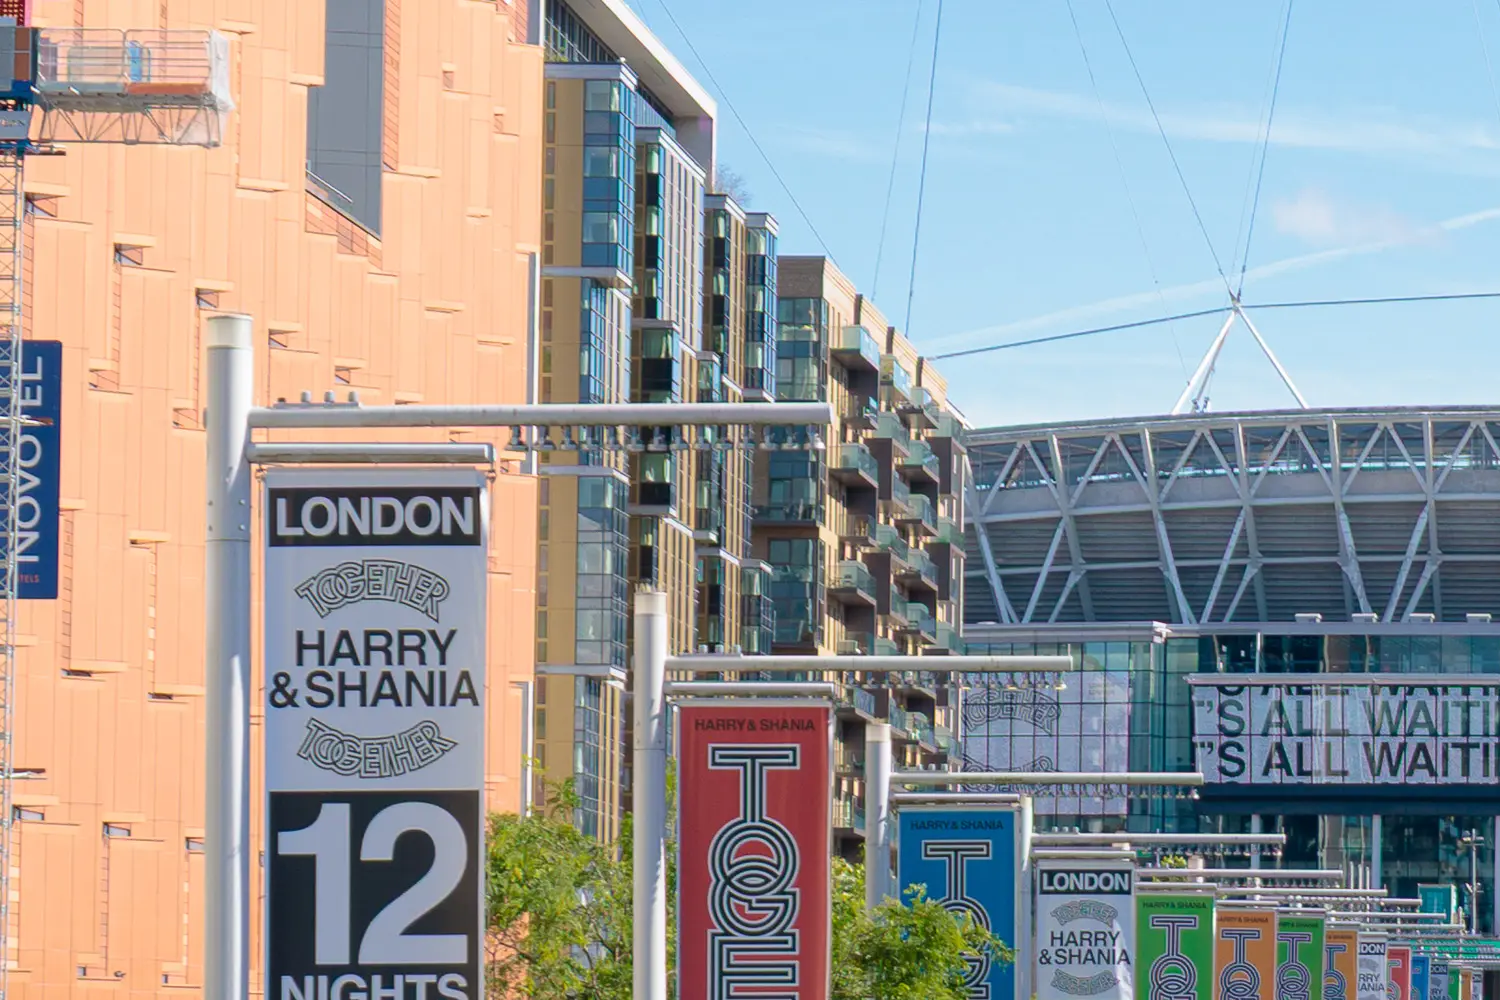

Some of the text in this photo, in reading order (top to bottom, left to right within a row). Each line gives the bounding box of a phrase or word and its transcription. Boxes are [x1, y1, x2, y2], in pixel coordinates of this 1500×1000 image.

[14, 356, 43, 562] NOVOEL
[275, 495, 474, 537] LONDON
[294, 559, 451, 623] TOGETHER
[295, 629, 458, 666] HARRY
[694, 719, 746, 731] HARRY
[760, 719, 816, 731] SHANIA
[1262, 700, 1349, 737] ALL
[297, 717, 458, 779] TOGETHER
[1262, 742, 1349, 777] ALL
[277, 801, 469, 965] 12
[1042, 872, 1129, 892] LONDON
[1050, 931, 1120, 947] HARRY
[1358, 943, 1385, 954] DON
